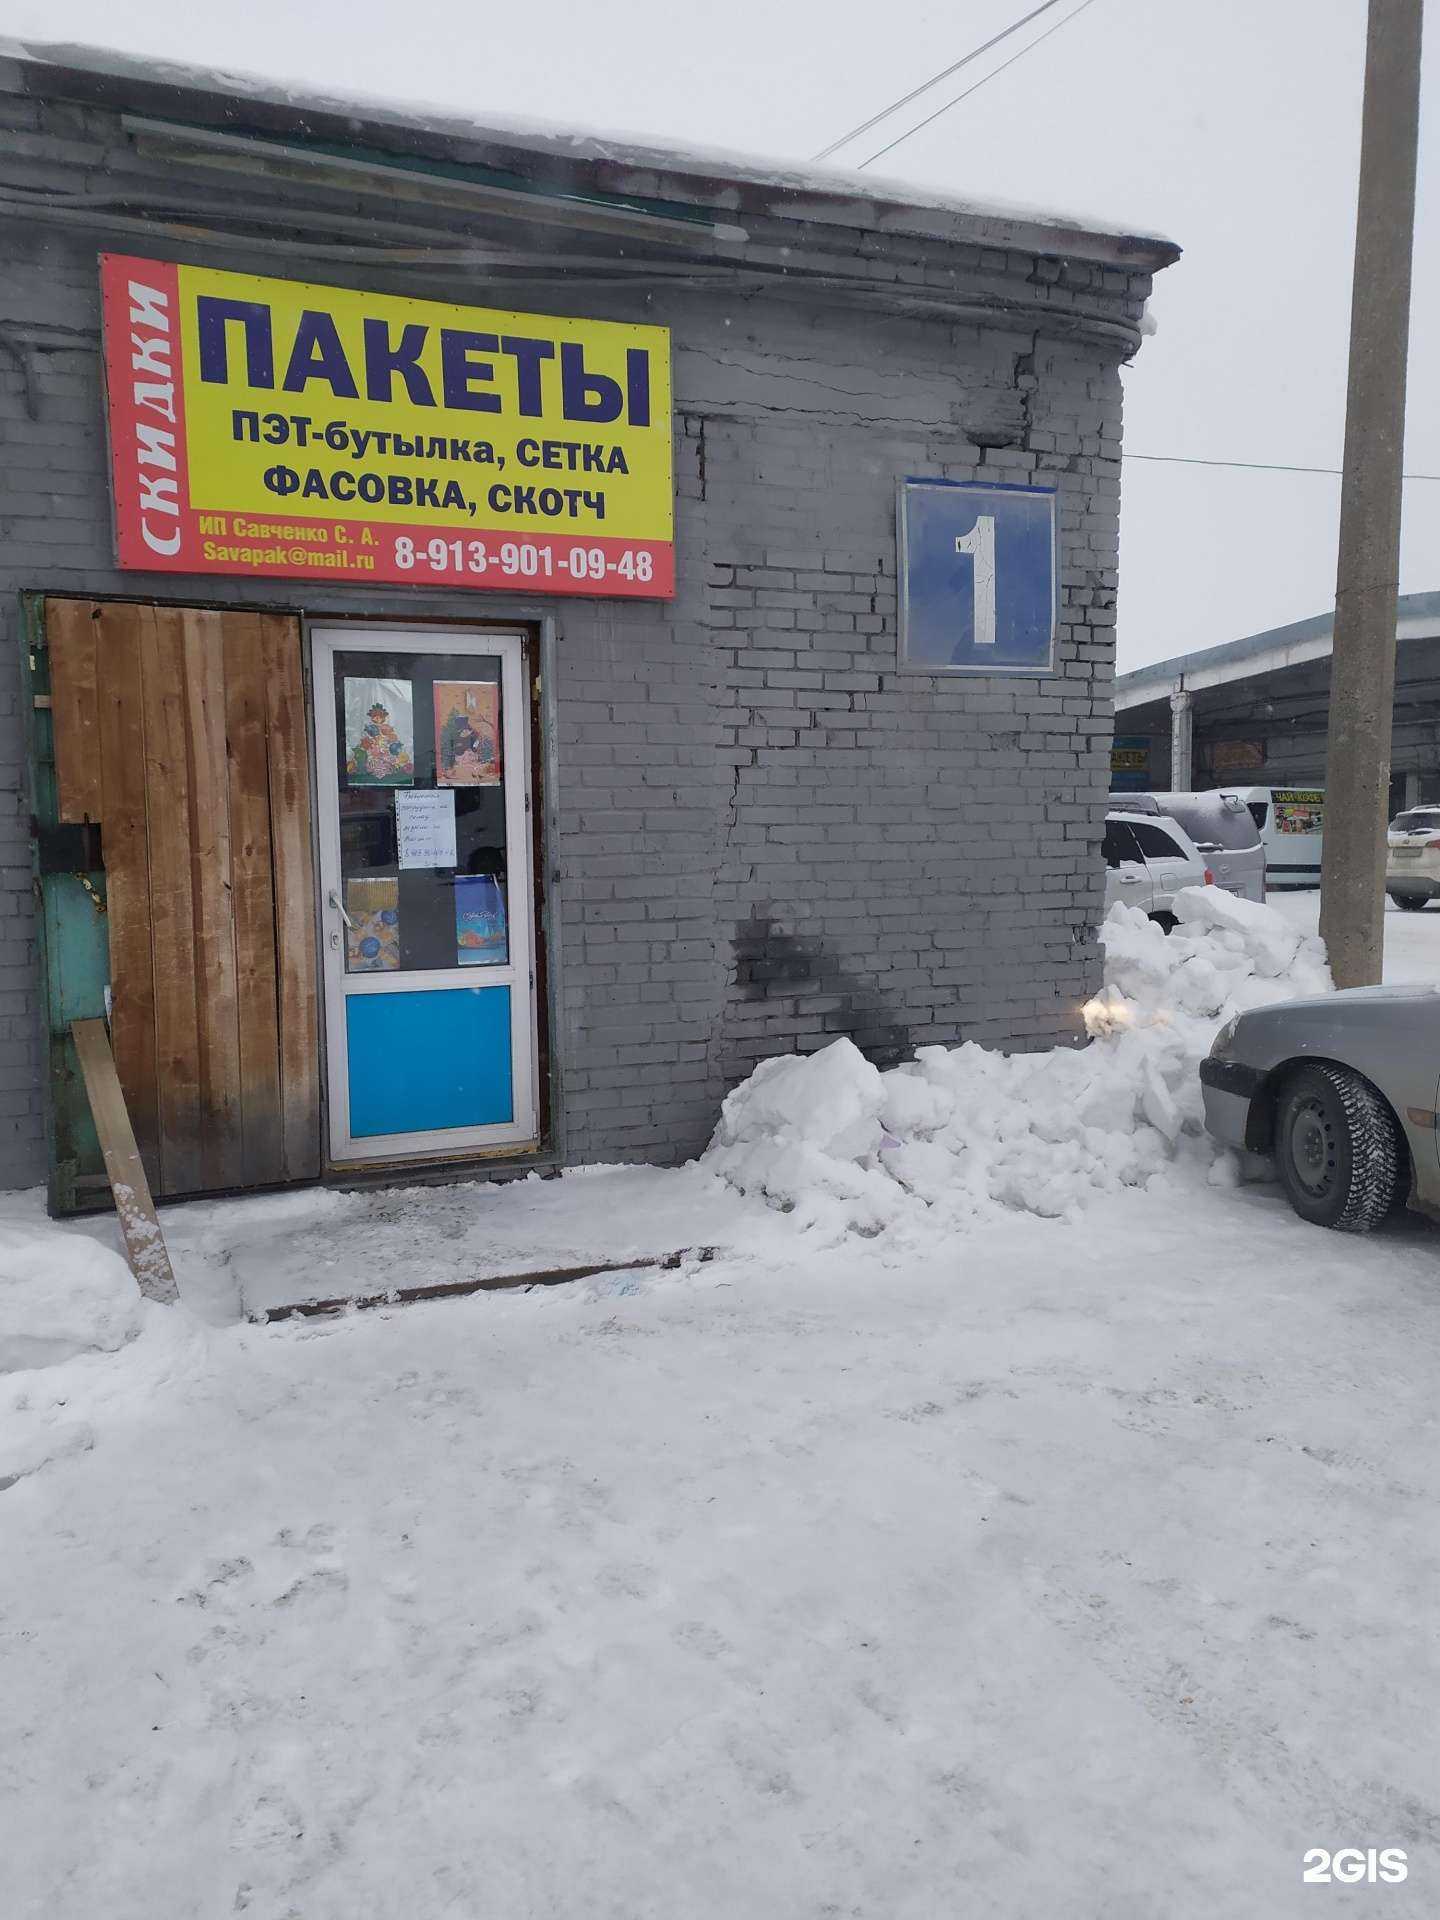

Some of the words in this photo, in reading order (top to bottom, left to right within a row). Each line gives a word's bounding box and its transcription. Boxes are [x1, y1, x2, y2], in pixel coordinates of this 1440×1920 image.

[196, 294, 650, 428] ПАКЕТЫ
[128, 279, 181, 556] СКИДКИ
[232, 409, 506, 471] ПЭТ-бутылка,
[516, 438, 630, 475] СЕТКА
[263, 464, 477, 517] ФАСОВКА,
[488, 483, 606, 519] СКОТЧ
[199, 514, 227, 536] ИП
[233, 518, 328, 543] Савченко
[334, 525, 354, 545] С.
[361, 527, 381, 546] А.
[203, 541, 375, 570] Savapak@mail.ru
[394, 536, 653, 582] 8-913-901-09-48
[956, 516, 996, 643] 1
